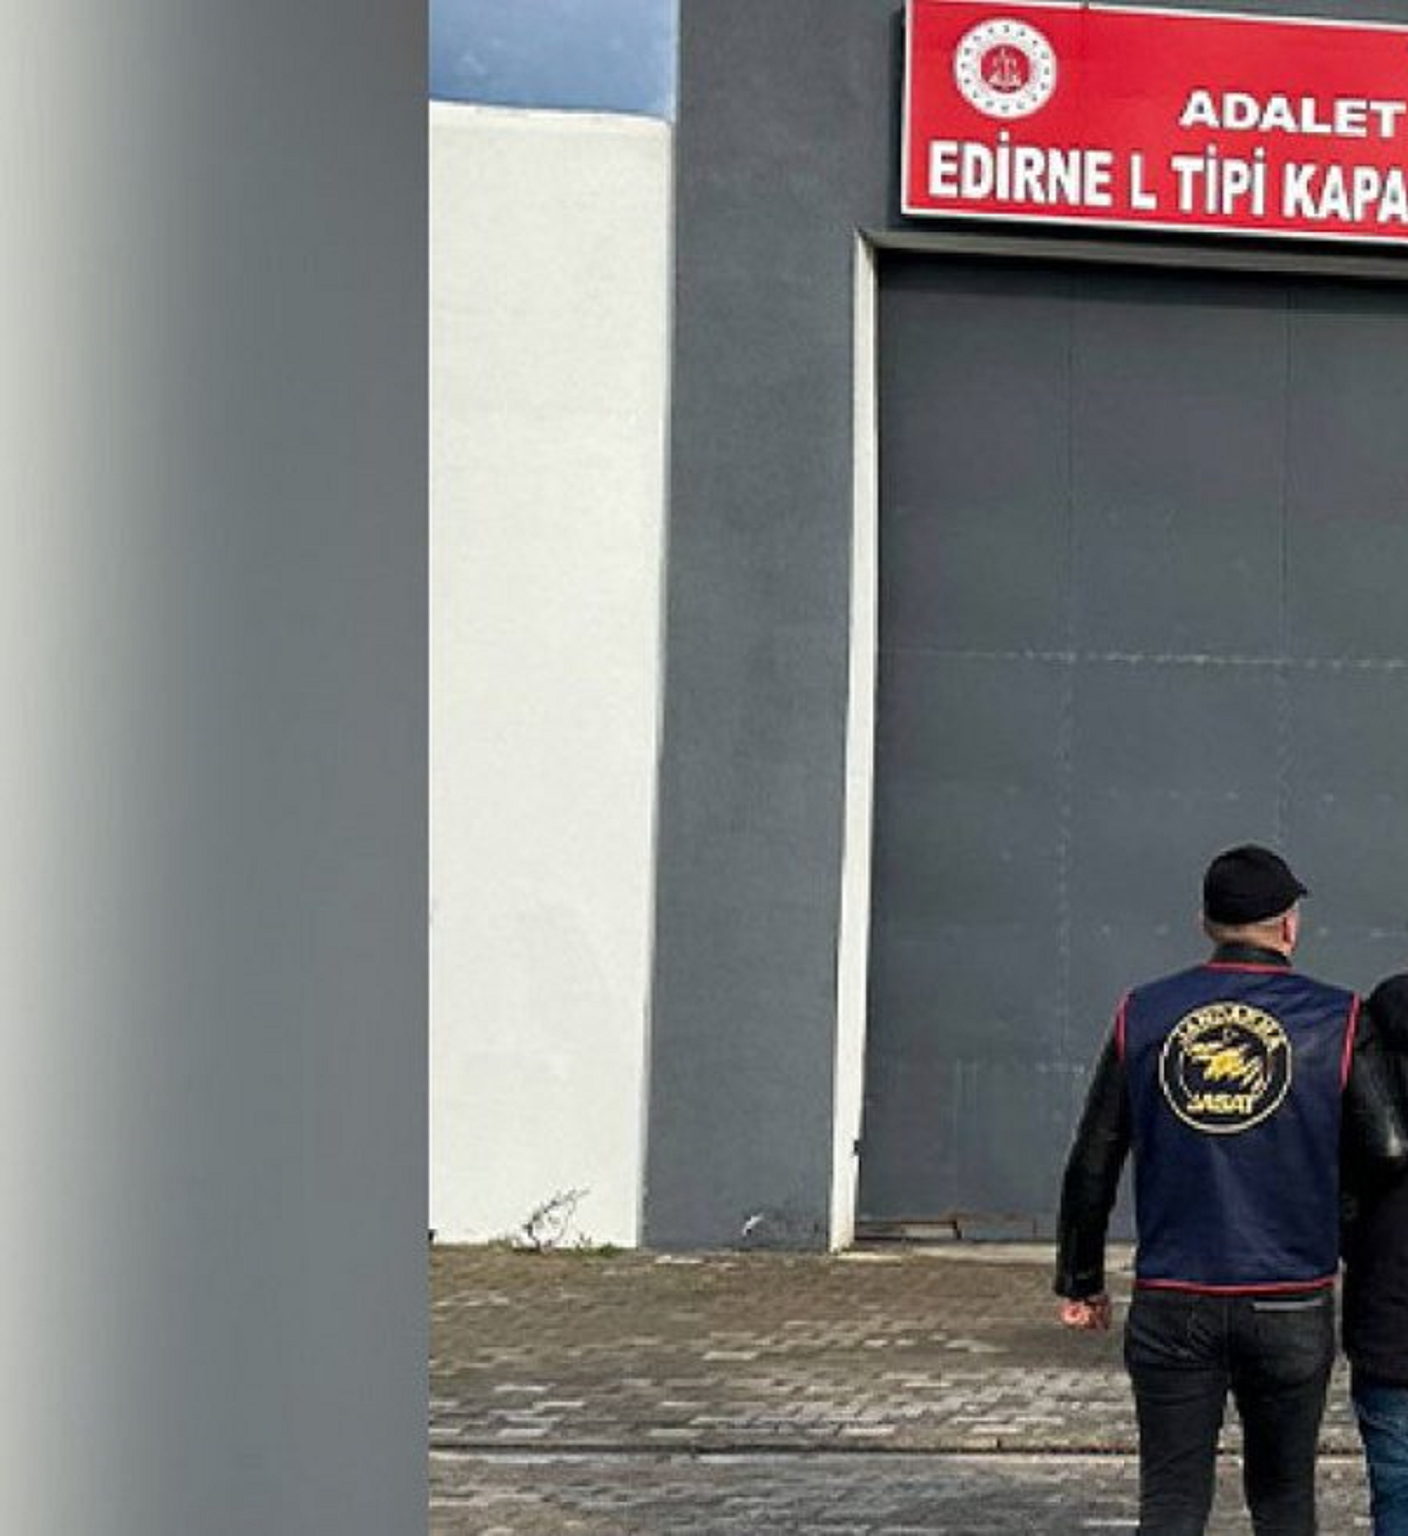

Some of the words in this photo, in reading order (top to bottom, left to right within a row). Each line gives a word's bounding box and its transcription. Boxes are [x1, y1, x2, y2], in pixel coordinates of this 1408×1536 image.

[1179, 90, 1407, 138] ADALET
[927, 131, 1113, 207] EDİRNE
[1130, 153, 1157, 210] L
[1171, 145, 1266, 216] TİPİ
